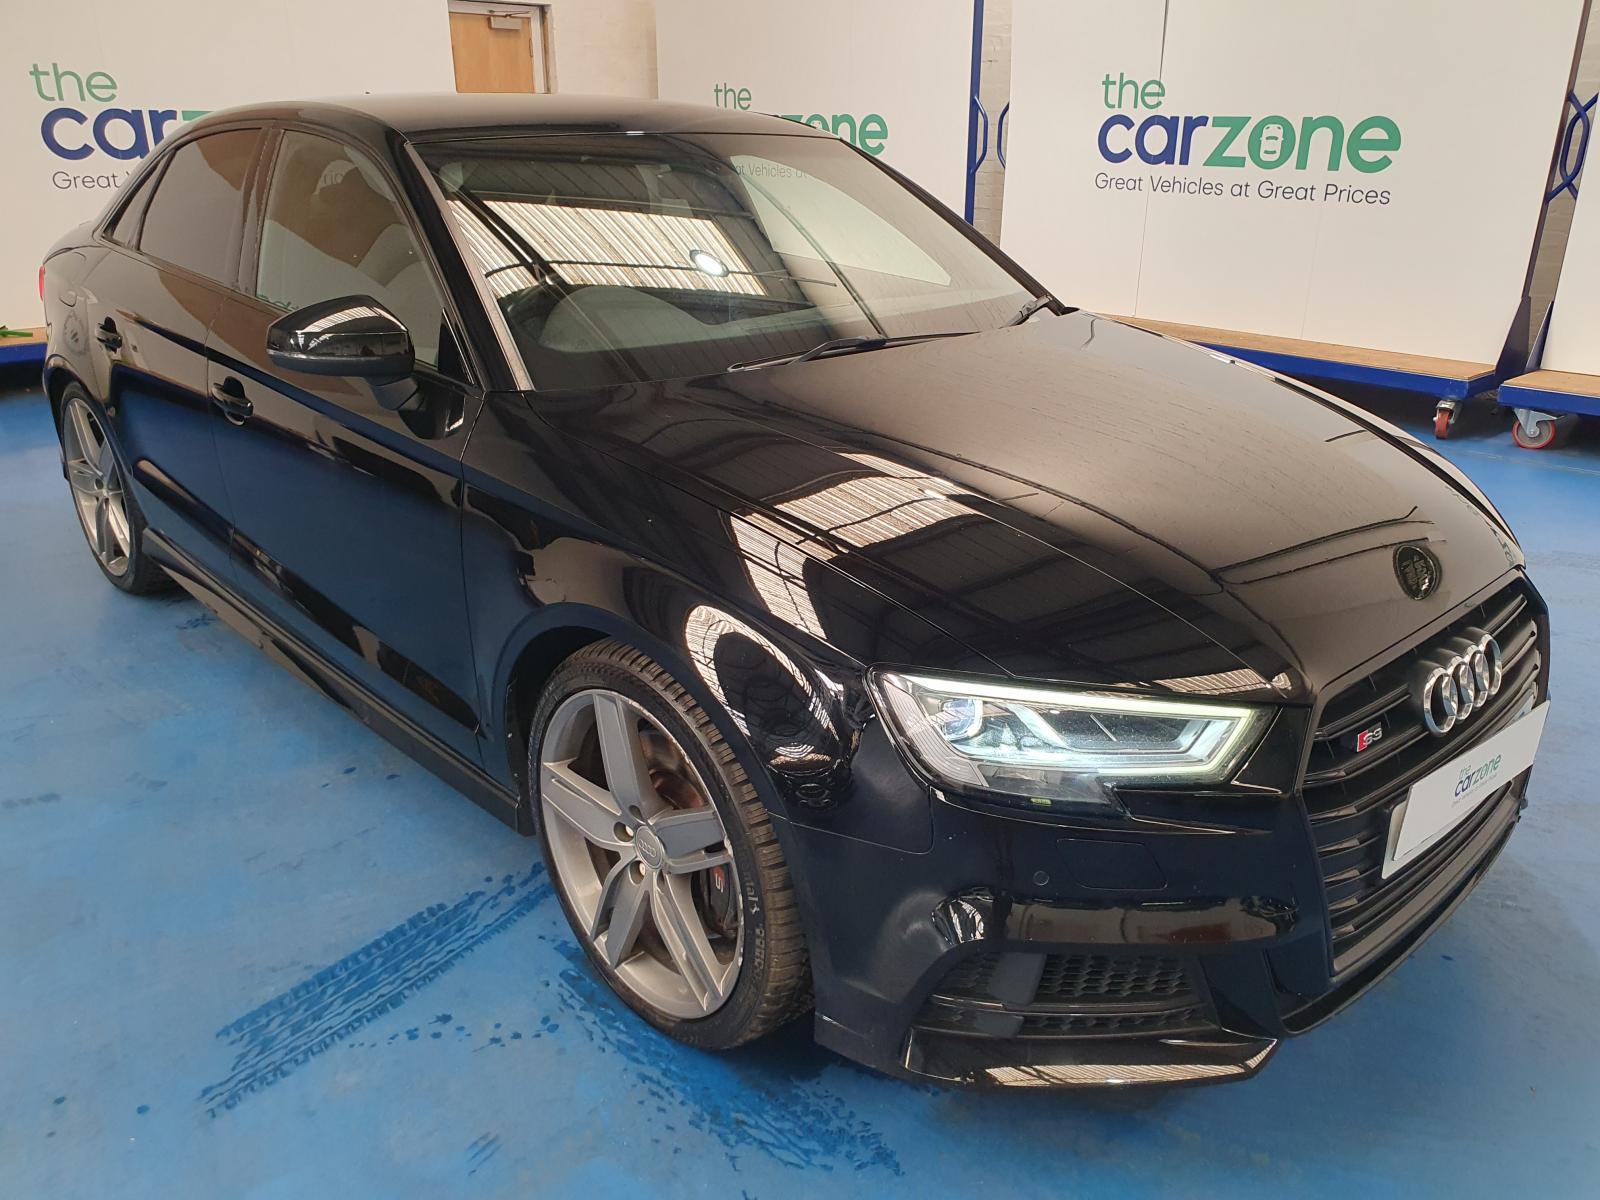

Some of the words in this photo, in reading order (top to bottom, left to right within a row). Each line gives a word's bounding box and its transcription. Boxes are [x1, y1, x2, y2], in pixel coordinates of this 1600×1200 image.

[29, 63, 118, 102] the
[714, 83, 752, 110] the
[1102, 72, 1166, 109] the
[41, 107, 213, 161] car
[1098, 114, 1401, 173] carzone
[52, 171, 120, 189] Great
[1095, 172, 1143, 191] Great
[1150, 175, 1224, 196] Vehicles
[1230, 182, 1250, 198] at
[1258, 180, 1316, 202] Great
[1324, 184, 1391, 205] Prices
[1454, 754, 1502, 797] carzone
